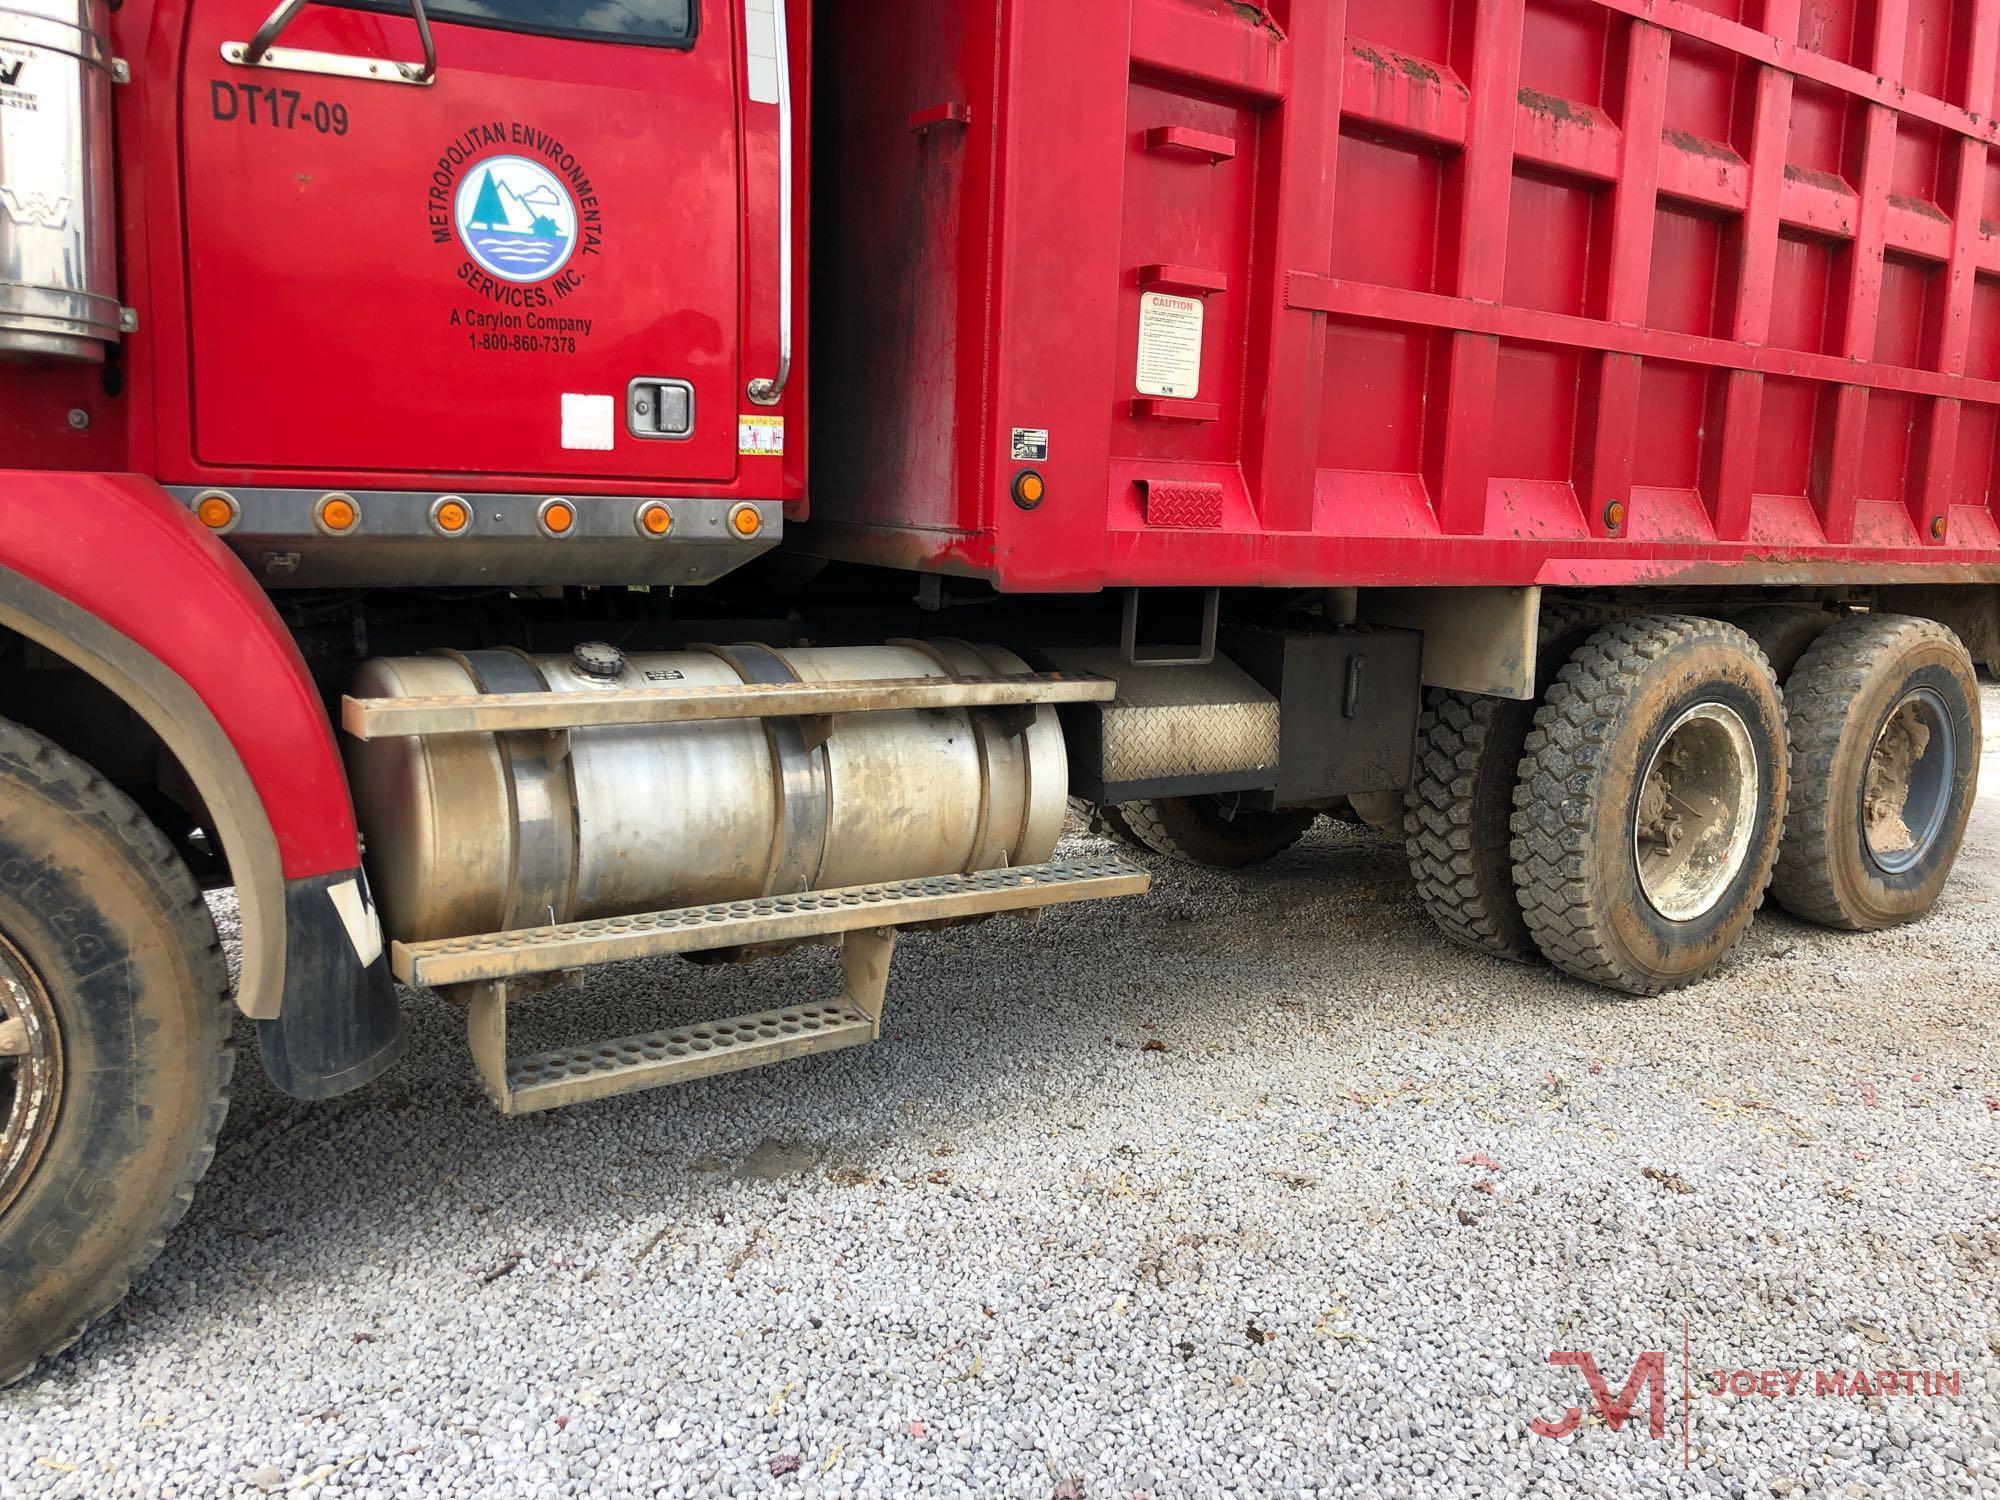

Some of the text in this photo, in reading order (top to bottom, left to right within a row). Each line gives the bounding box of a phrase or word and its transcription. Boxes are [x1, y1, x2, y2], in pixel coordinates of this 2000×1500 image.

[210, 79, 349, 136] DT17-09
[428, 121, 602, 256] METROPOLITAN ENVIRONMENTAL
[457, 261, 586, 308] SERVICES, INC.
[450, 308, 592, 336] A Carylon Company
[1152, 296, 1194, 312] CAUTION
[469, 332, 577, 353] 1-800-860-7378
